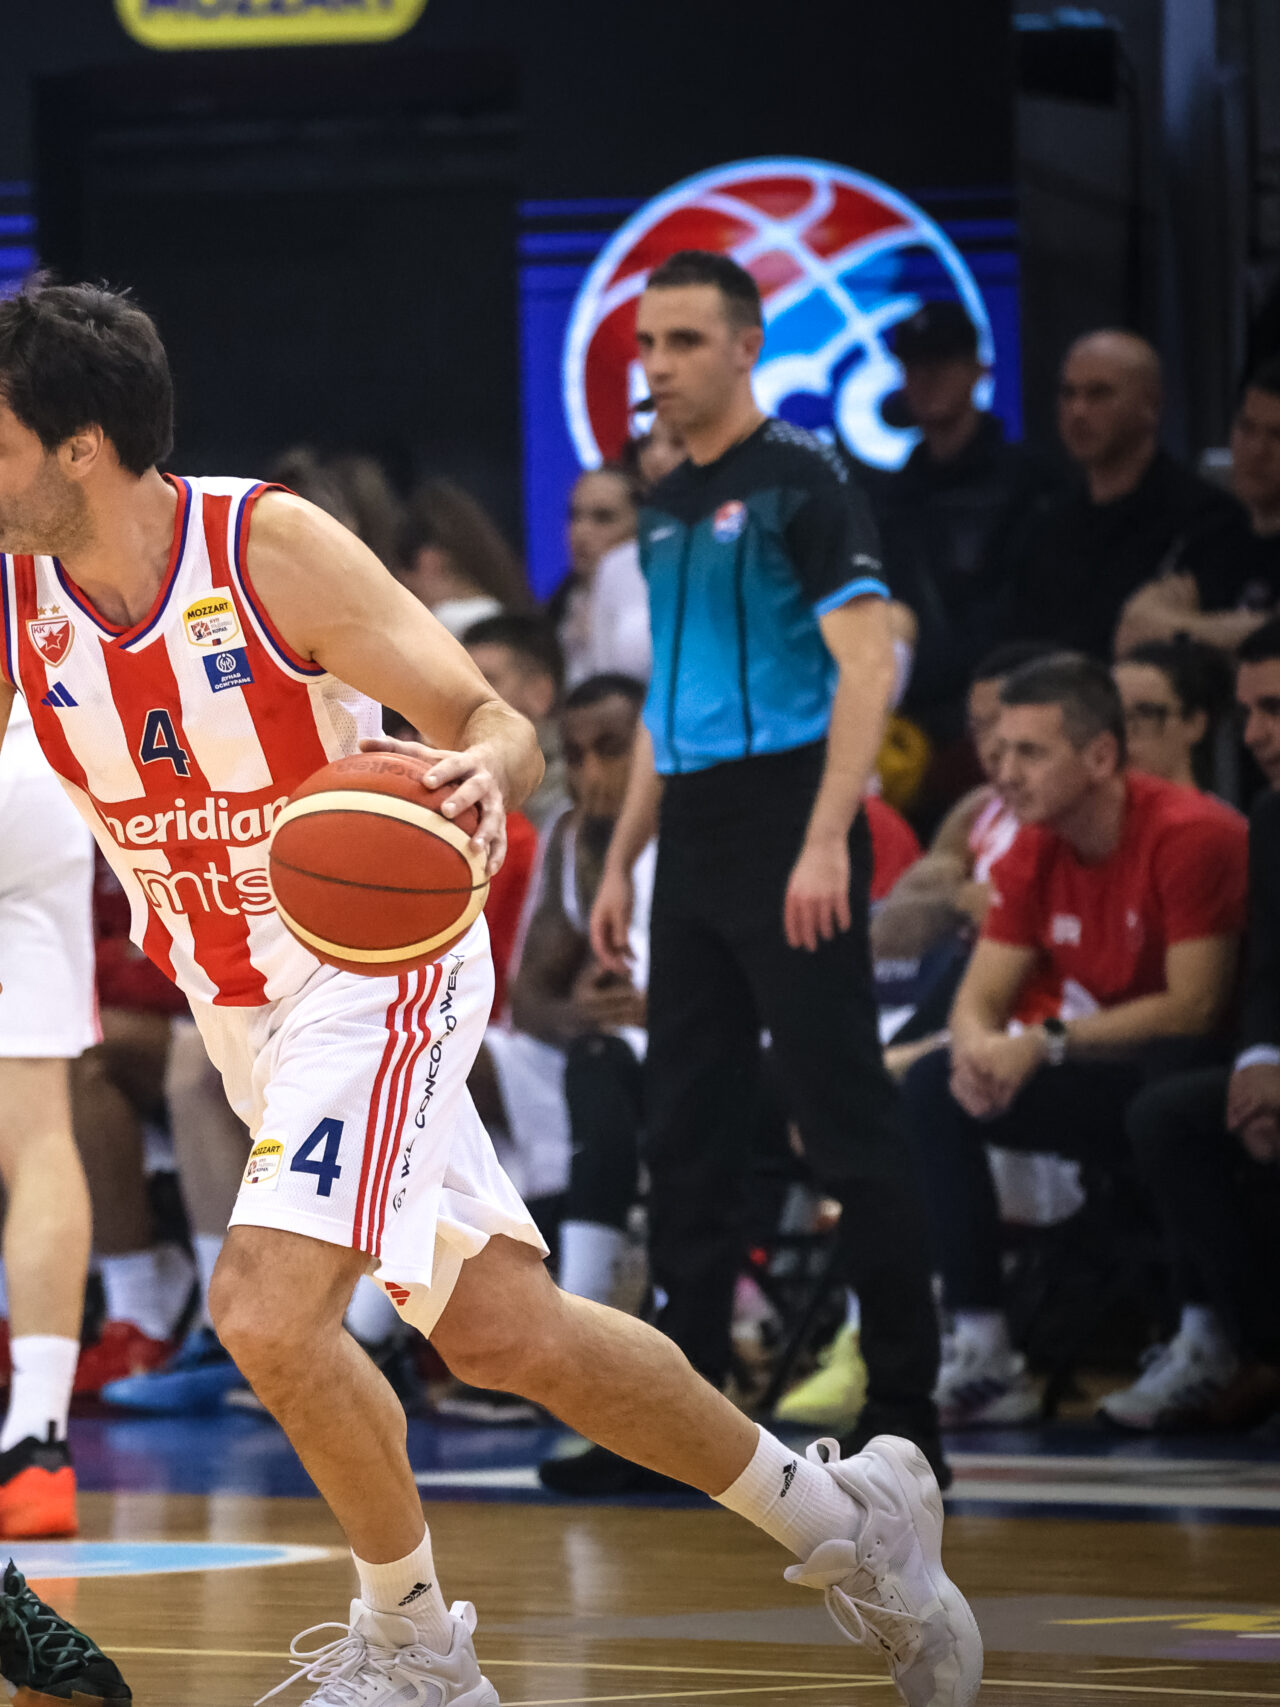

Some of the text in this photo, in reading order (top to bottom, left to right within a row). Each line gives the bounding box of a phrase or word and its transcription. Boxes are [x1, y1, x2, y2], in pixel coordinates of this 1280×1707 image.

[187, 602, 228, 619] MOZZART
[139, 708, 191, 777] 4
[133, 861, 277, 916] mts
[290, 1117, 345, 1197] 4
